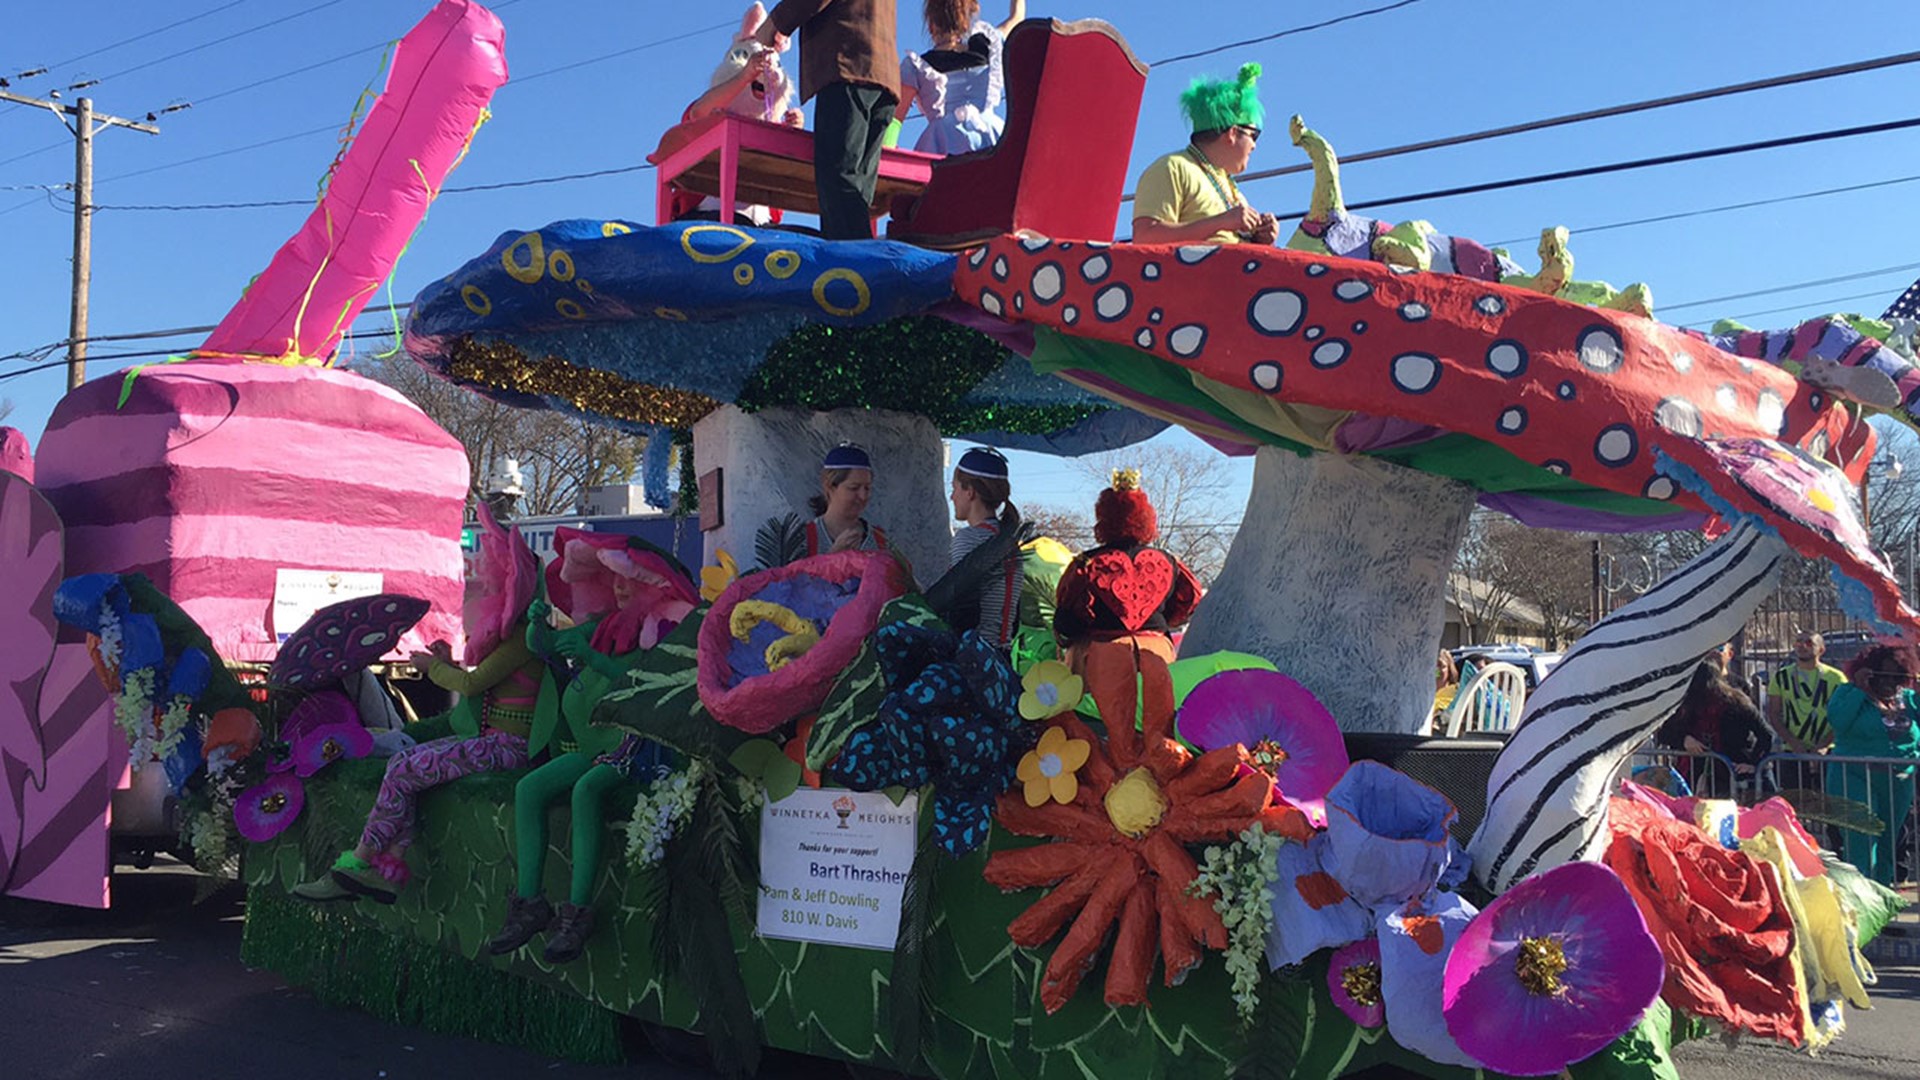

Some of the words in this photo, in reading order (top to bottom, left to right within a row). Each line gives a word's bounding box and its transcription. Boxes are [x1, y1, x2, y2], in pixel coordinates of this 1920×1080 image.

[770, 808, 831, 820] WINNETKA
[858, 813, 912, 825] HEIGHTS
[798, 842, 821, 852] Thanks
[822, 844, 832, 853] for
[833, 846, 849, 856] your
[850, 847, 879, 857] support!
[809, 862, 840, 879] Bart
[842, 864, 907, 884] Thrasher
[763, 885, 789, 900] Pam
[791, 887, 802, 901] &
[804, 889, 827, 903] Jeff
[829, 890, 880, 912] Dowling
[781, 909, 804, 924] 810
[807, 911, 822, 926] W.
[825, 913, 859, 930] Davis
